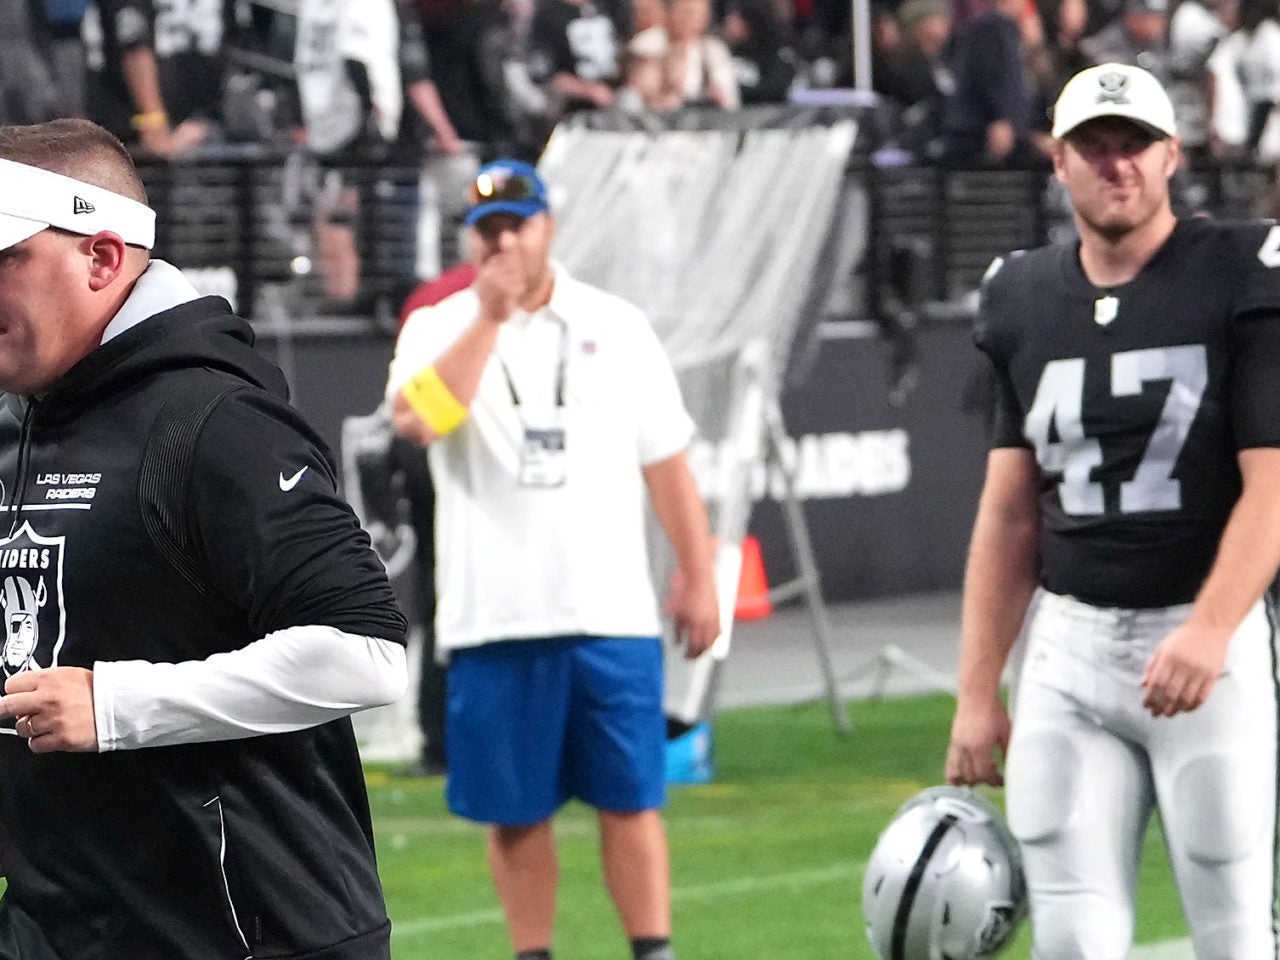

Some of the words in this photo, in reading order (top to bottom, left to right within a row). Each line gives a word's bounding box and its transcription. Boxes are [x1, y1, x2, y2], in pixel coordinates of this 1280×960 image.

[1024, 344, 1208, 515] 47
[36, 473, 61, 485] LAS
[61, 473, 102, 484] VEGAS
[45, 487, 97, 499] RAIDERS
